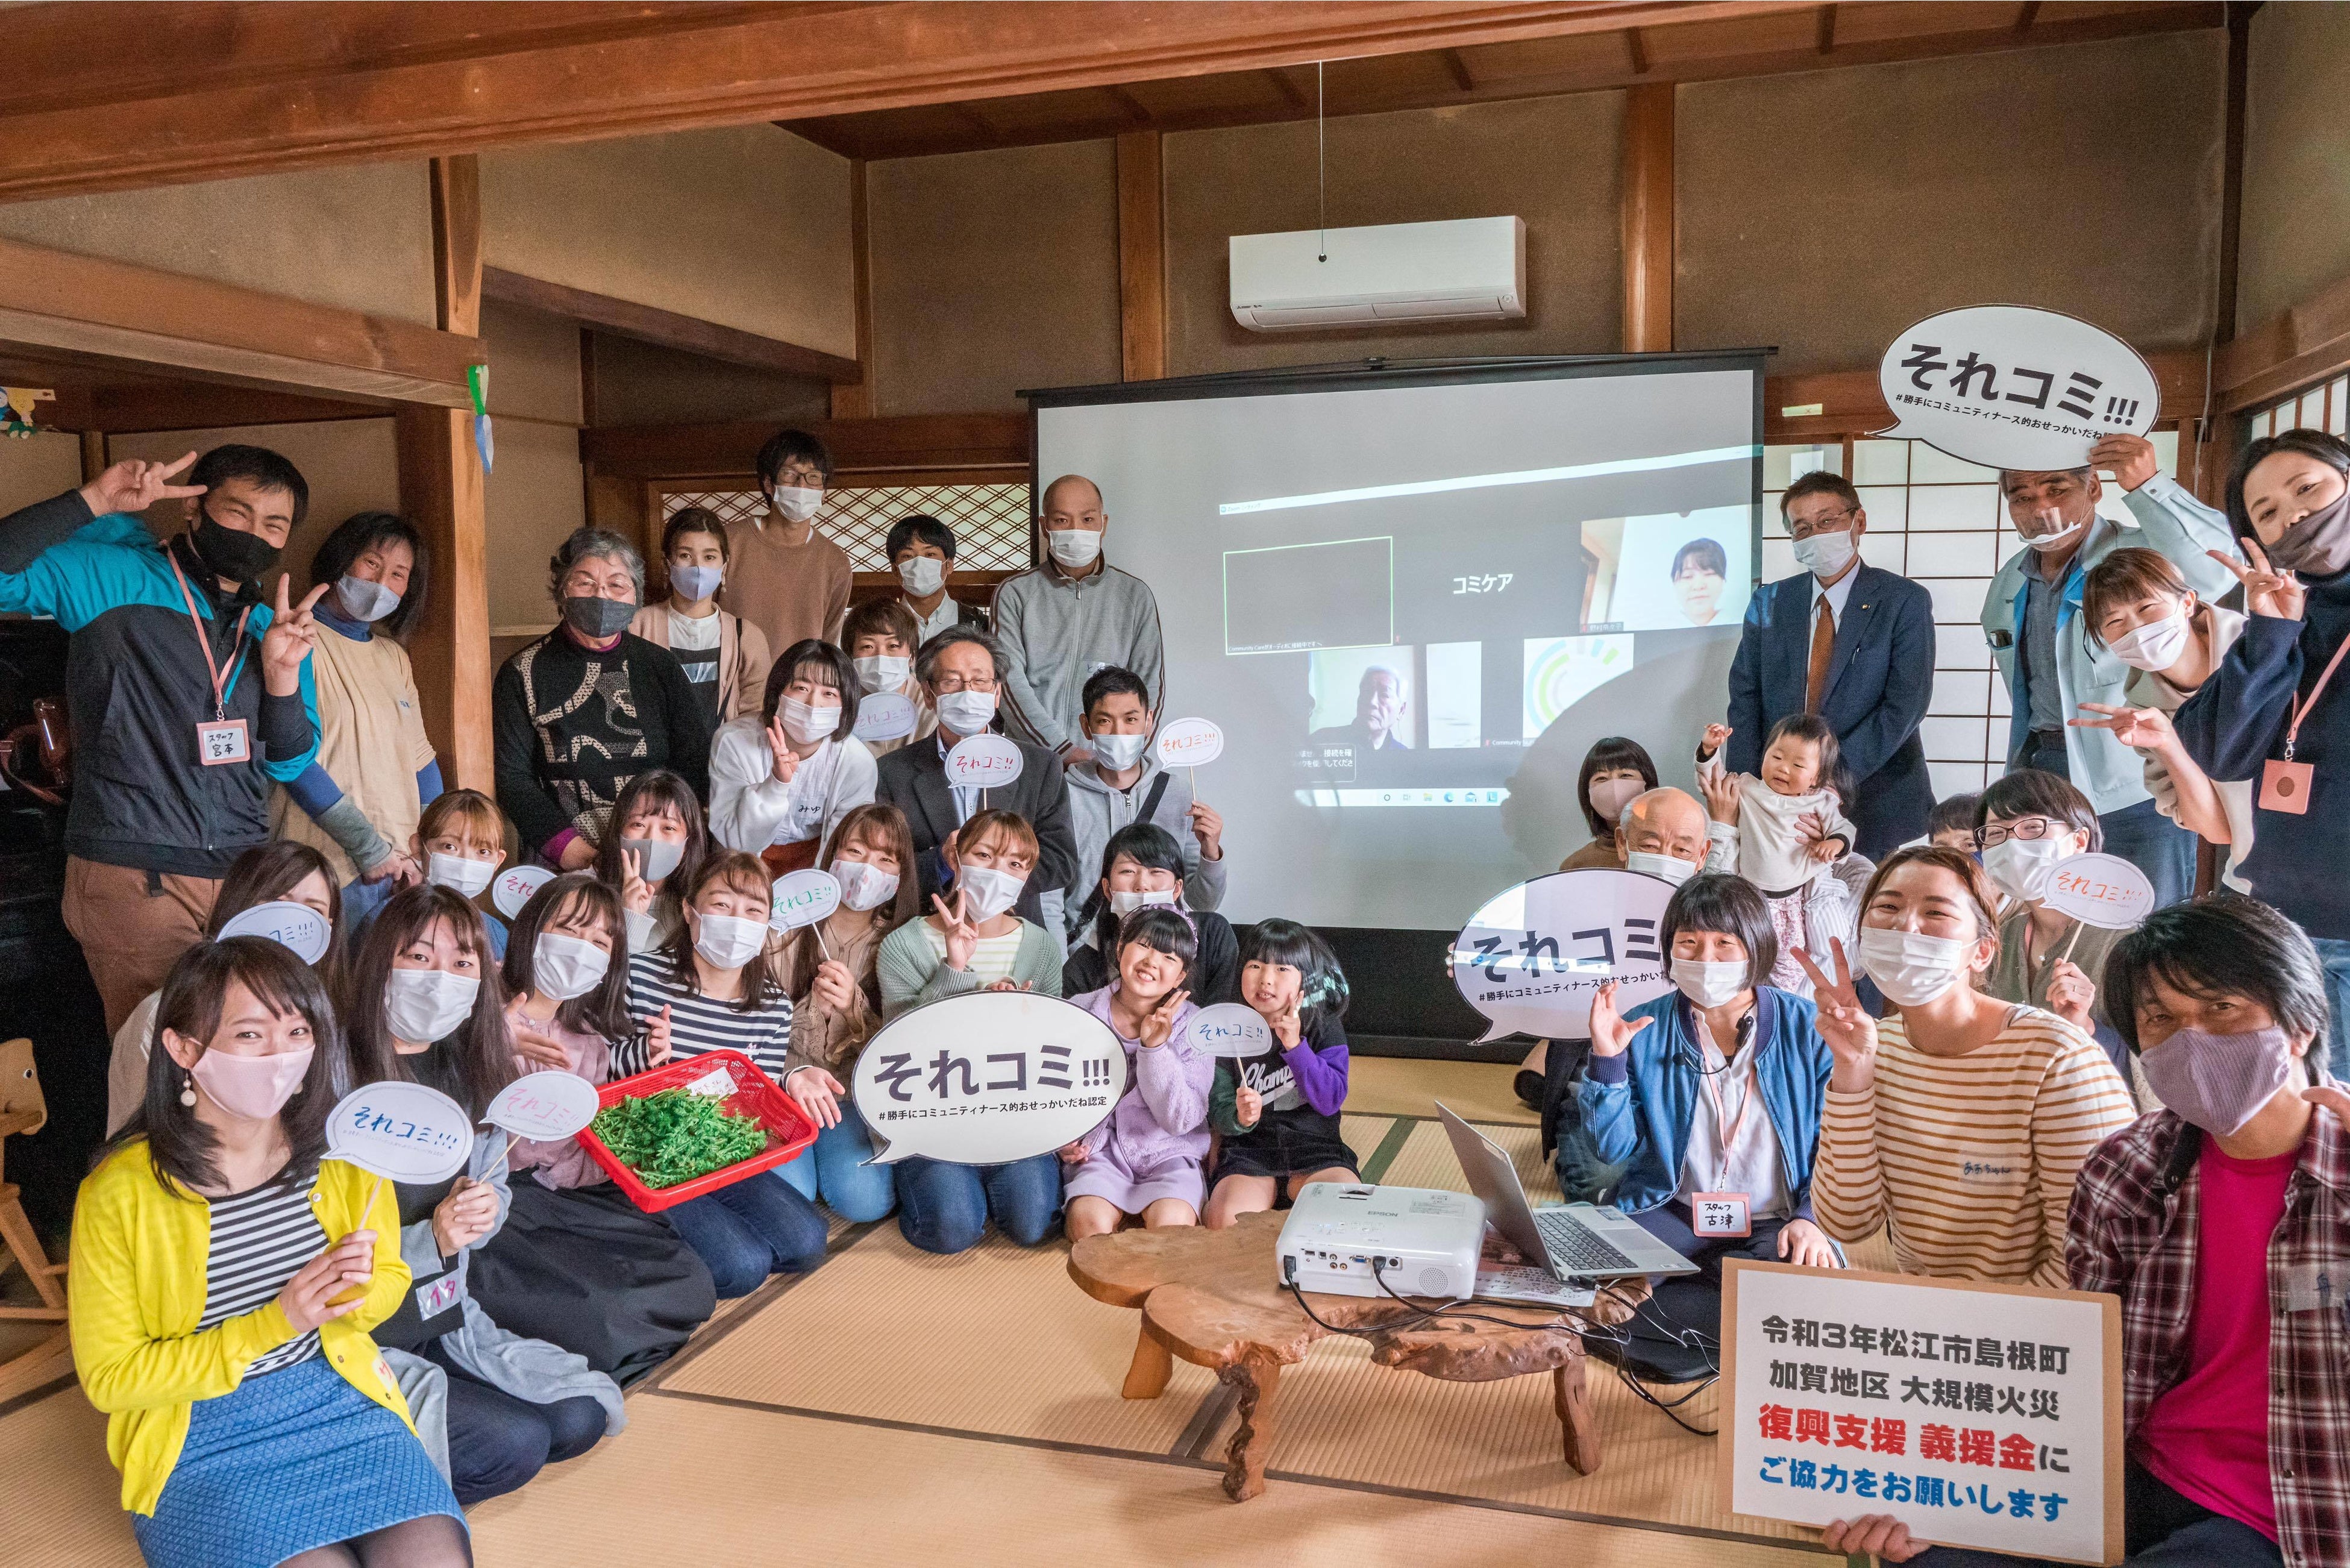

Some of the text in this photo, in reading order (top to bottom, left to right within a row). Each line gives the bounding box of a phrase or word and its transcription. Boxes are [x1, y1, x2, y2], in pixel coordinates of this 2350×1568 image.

[1901, 343, 2139, 426] それコミ!!!
[1453, 574, 1514, 594] コミケア
[798, 805, 821, 814] みゆ
[874, 1044, 1111, 1102] それコミ!!!
[1761, 1314, 2070, 1375] 令和3年松江市島根町
[1769, 1359, 2061, 1422] 加賀地区 大規模火災
[1758, 1403, 2070, 1473] 復興支援 義援金に
[1759, 1455, 2070, 1523] ご協力をお願いします
